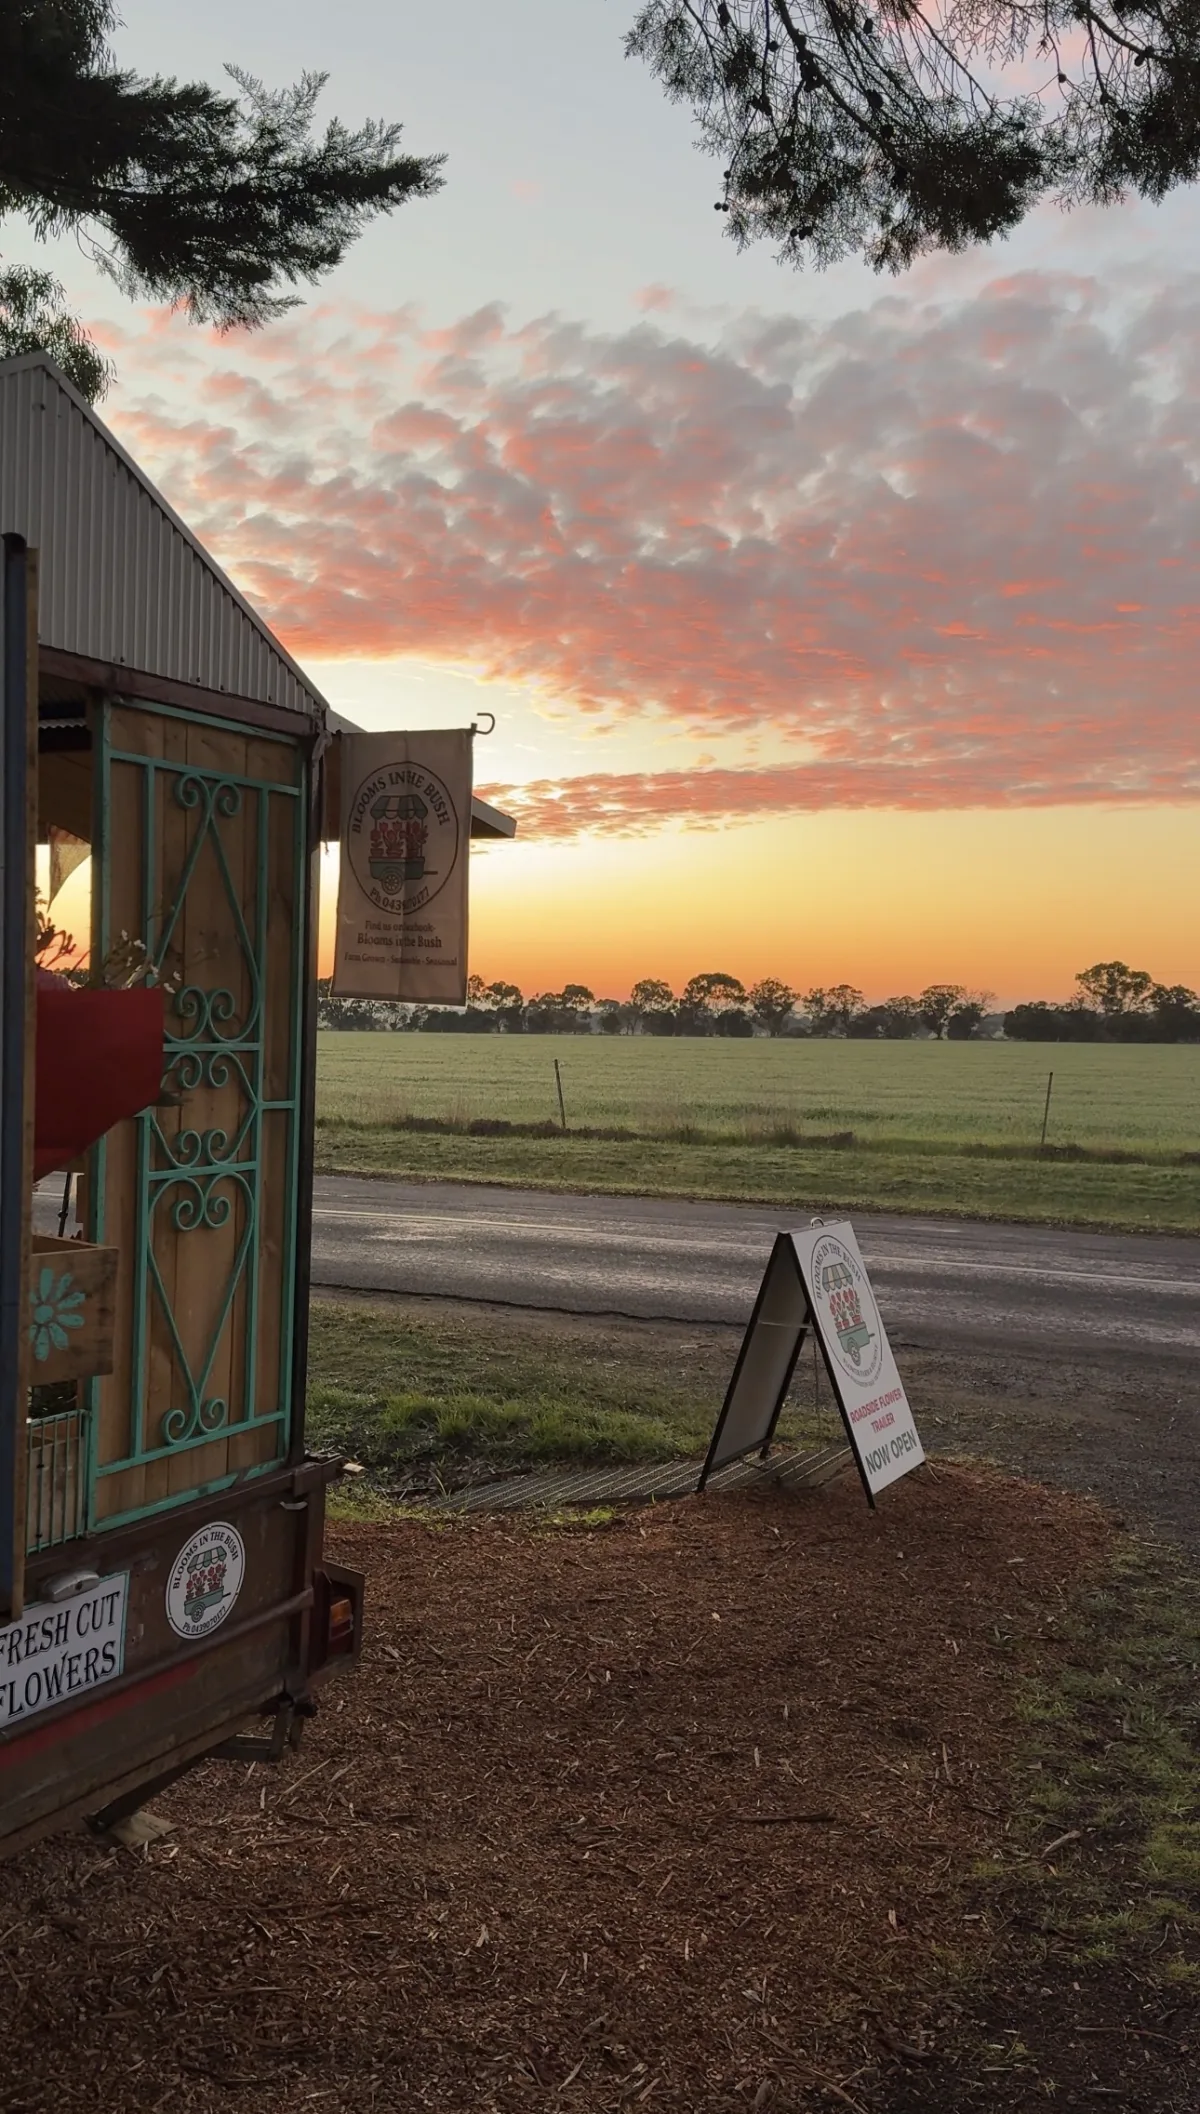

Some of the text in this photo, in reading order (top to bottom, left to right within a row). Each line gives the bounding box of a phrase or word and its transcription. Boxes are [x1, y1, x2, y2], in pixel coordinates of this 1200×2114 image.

[352, 776, 387, 834] BLOOMS
[423, 782, 450, 826] BUSH
[357, 932, 394, 946] Blooms
[417, 935, 442, 948] Bush
[365, 920, 381, 931] Find
[814, 1250, 824, 1300] BLOOMS
[820, 1243, 830, 1257] IN
[828, 1242, 842, 1258] THE
[849, 1388, 902, 1424] ROADSIDE FLOWER
[870, 1412, 896, 1434] TRAILER
[865, 1428, 918, 1475] NOW OPEN
[173, 1531, 239, 1590] BLOOMS IN THE BUSH
[76, 1591, 121, 1638] CUT
